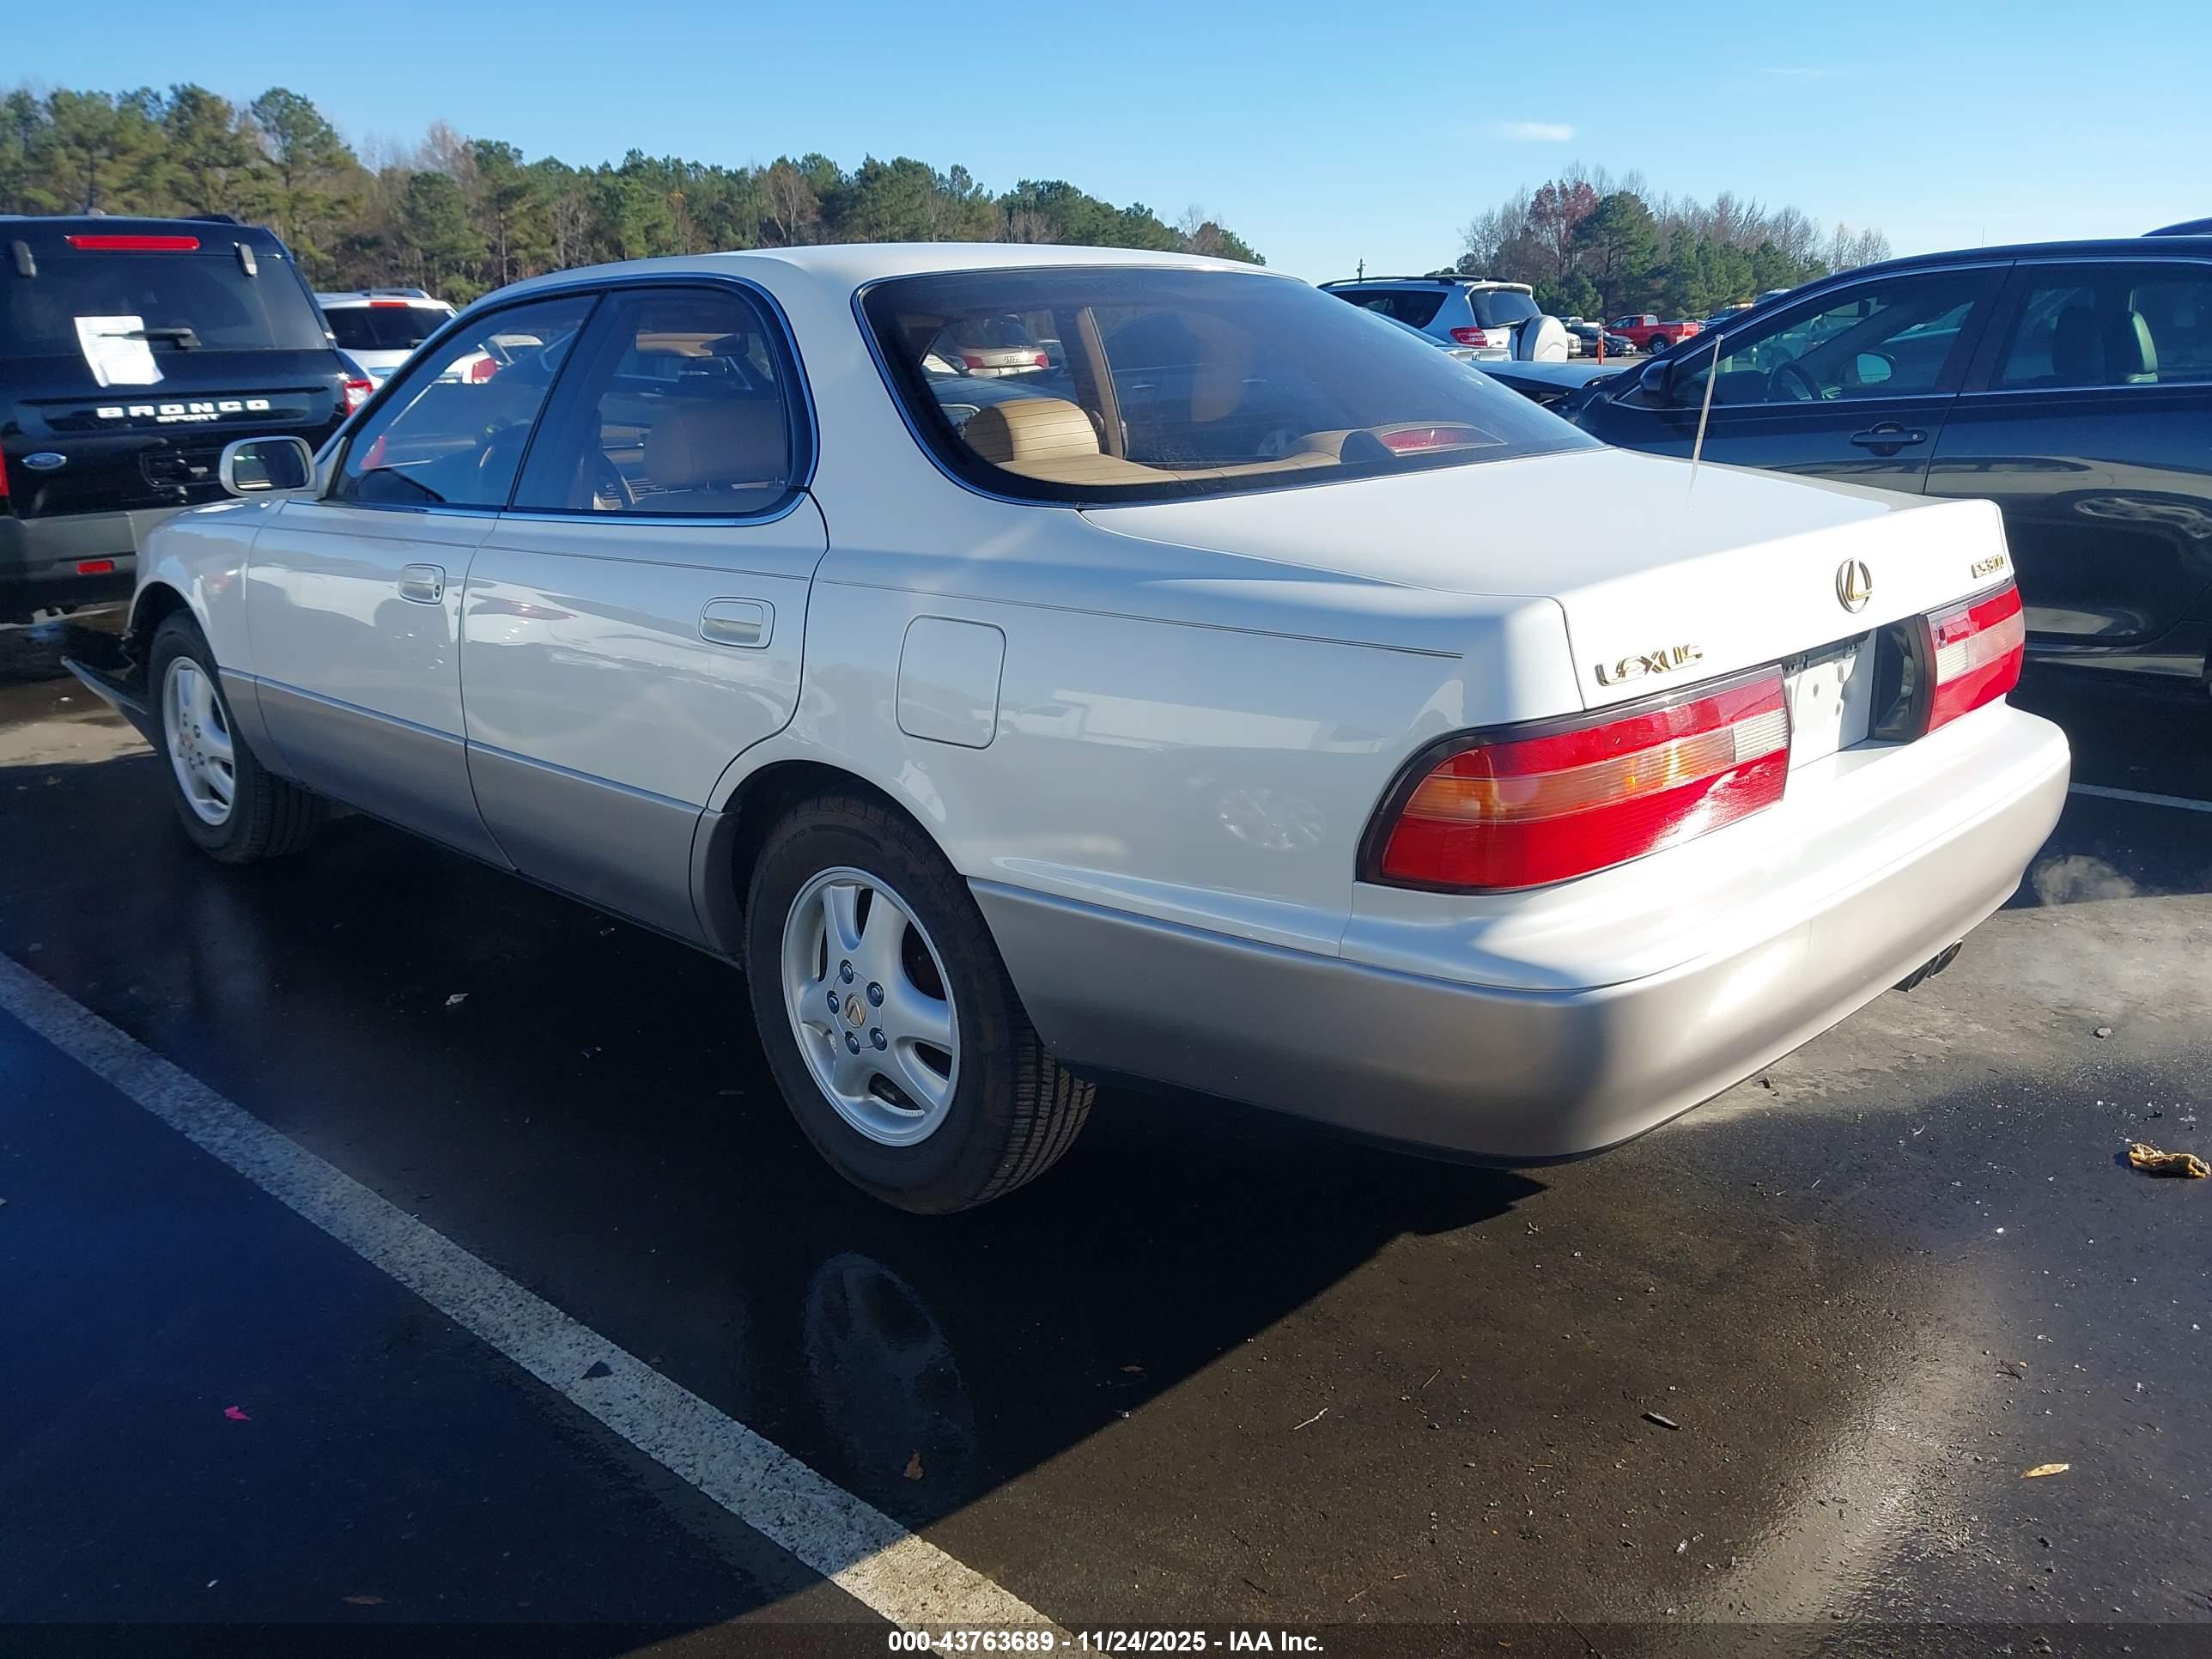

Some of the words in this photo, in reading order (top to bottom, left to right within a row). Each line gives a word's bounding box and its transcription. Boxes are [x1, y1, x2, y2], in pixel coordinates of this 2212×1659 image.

[96, 399, 270, 419] BRONCO
[155, 413, 221, 423] SPORT
[1594, 643, 1704, 687] LEXUS
